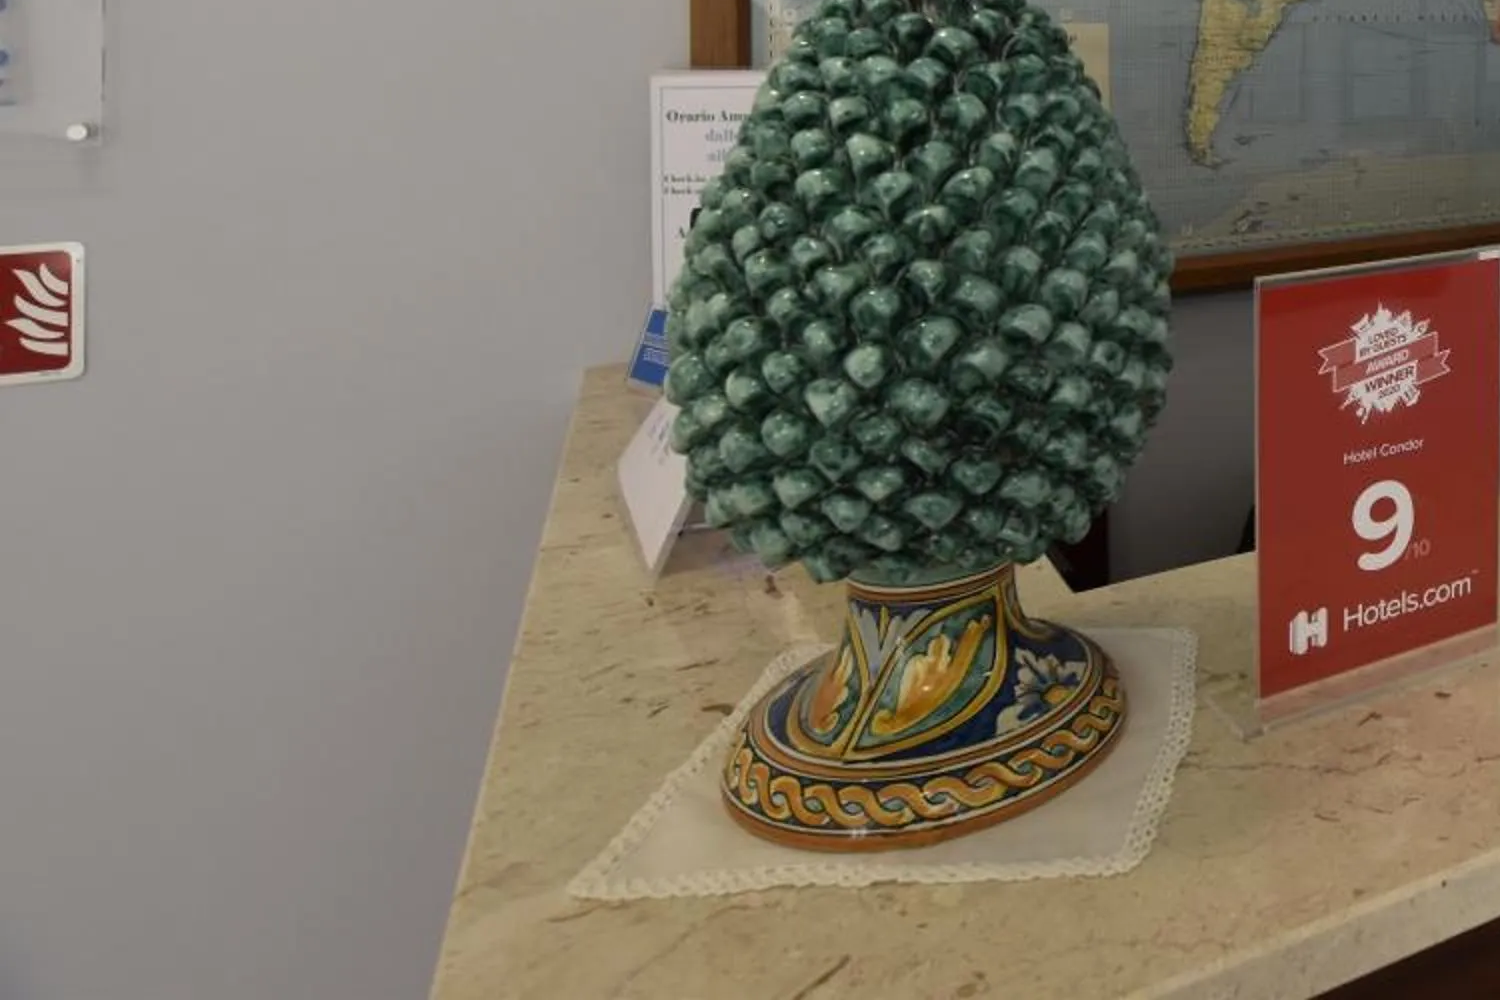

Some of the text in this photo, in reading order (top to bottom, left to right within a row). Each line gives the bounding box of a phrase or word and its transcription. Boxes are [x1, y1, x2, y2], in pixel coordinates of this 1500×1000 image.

[1367, 326, 1400, 343] LOVED
[1365, 348, 1410, 375] AWARD
[1363, 365, 1416, 393] WINNER
[1343, 436, 1424, 465] Hotel Condor
[1351, 479, 1415, 572] 9
[1343, 574, 1473, 633] Hotels.com
